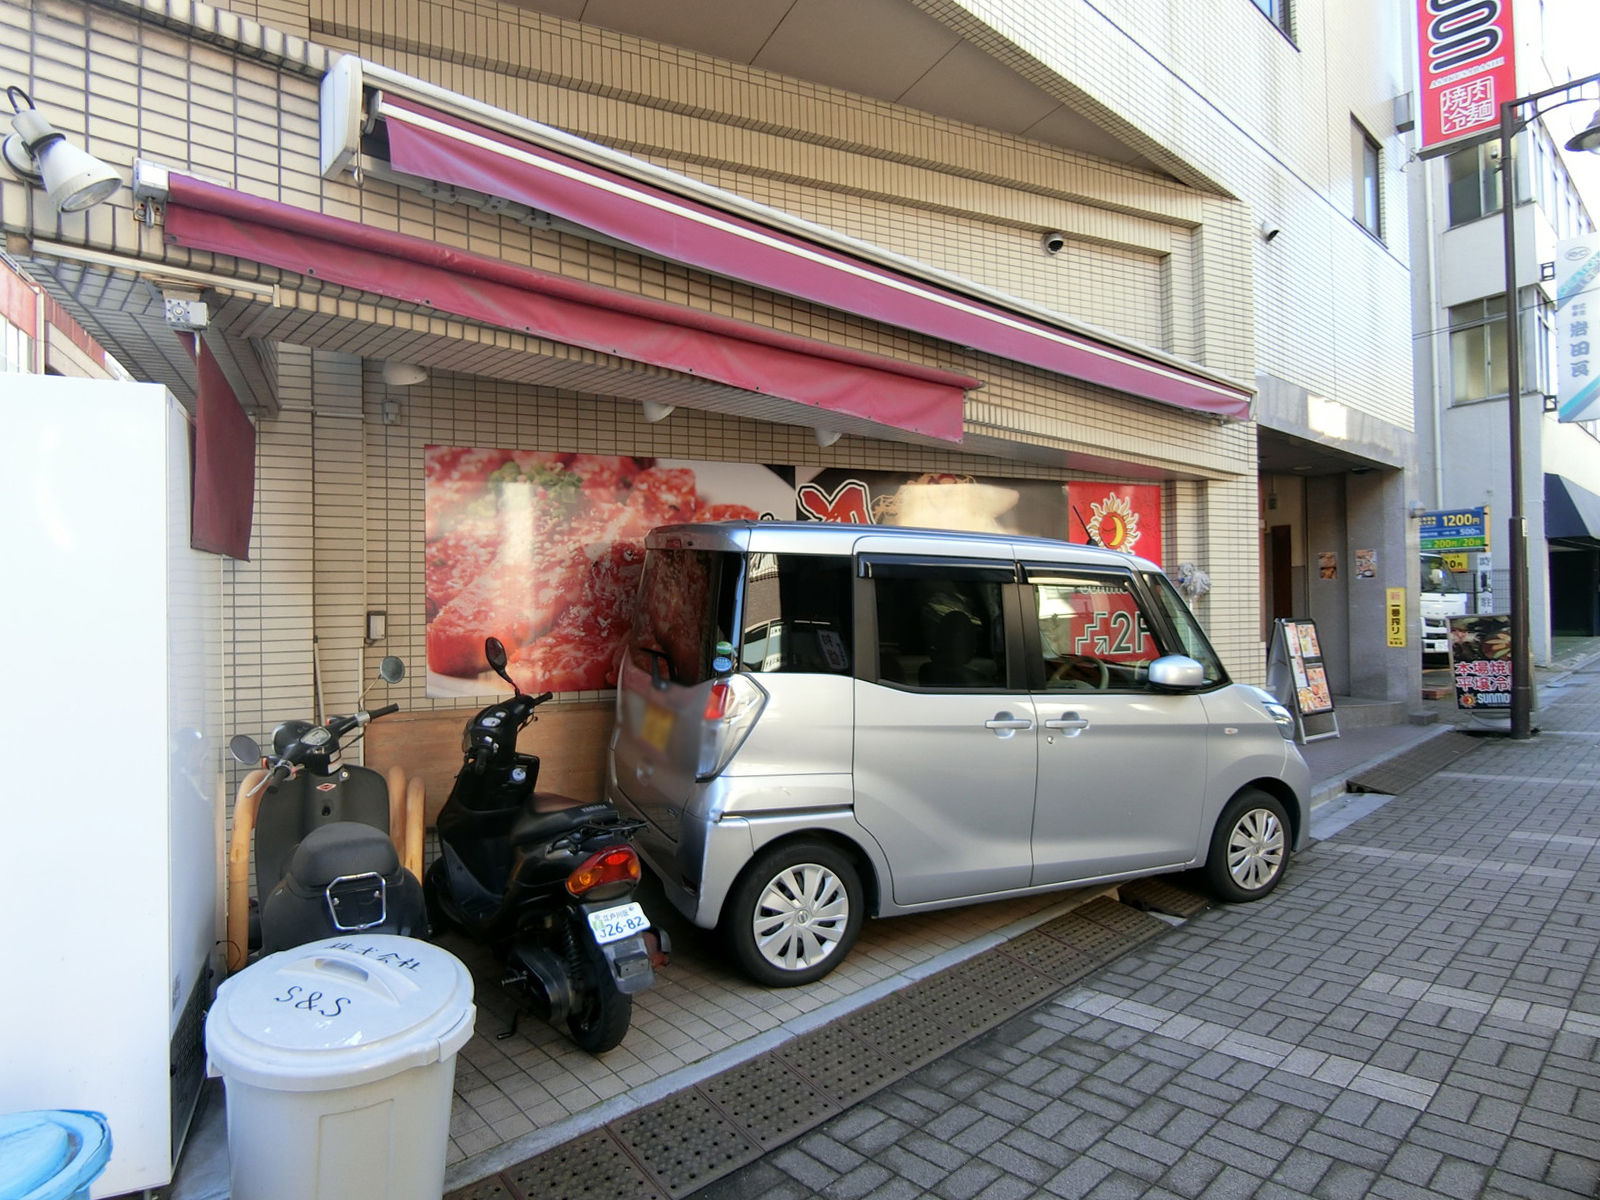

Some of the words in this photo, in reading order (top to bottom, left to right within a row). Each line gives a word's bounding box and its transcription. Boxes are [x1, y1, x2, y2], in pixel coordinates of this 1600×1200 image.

[1442, 81, 1490, 111] 焼肉
[1442, 514, 1480, 527] 1200円
[1455, 660, 1512, 676] 本場焼
[1455, 676, 1512, 692] 平壌冷
[273, 985, 351, 1017] S&S
